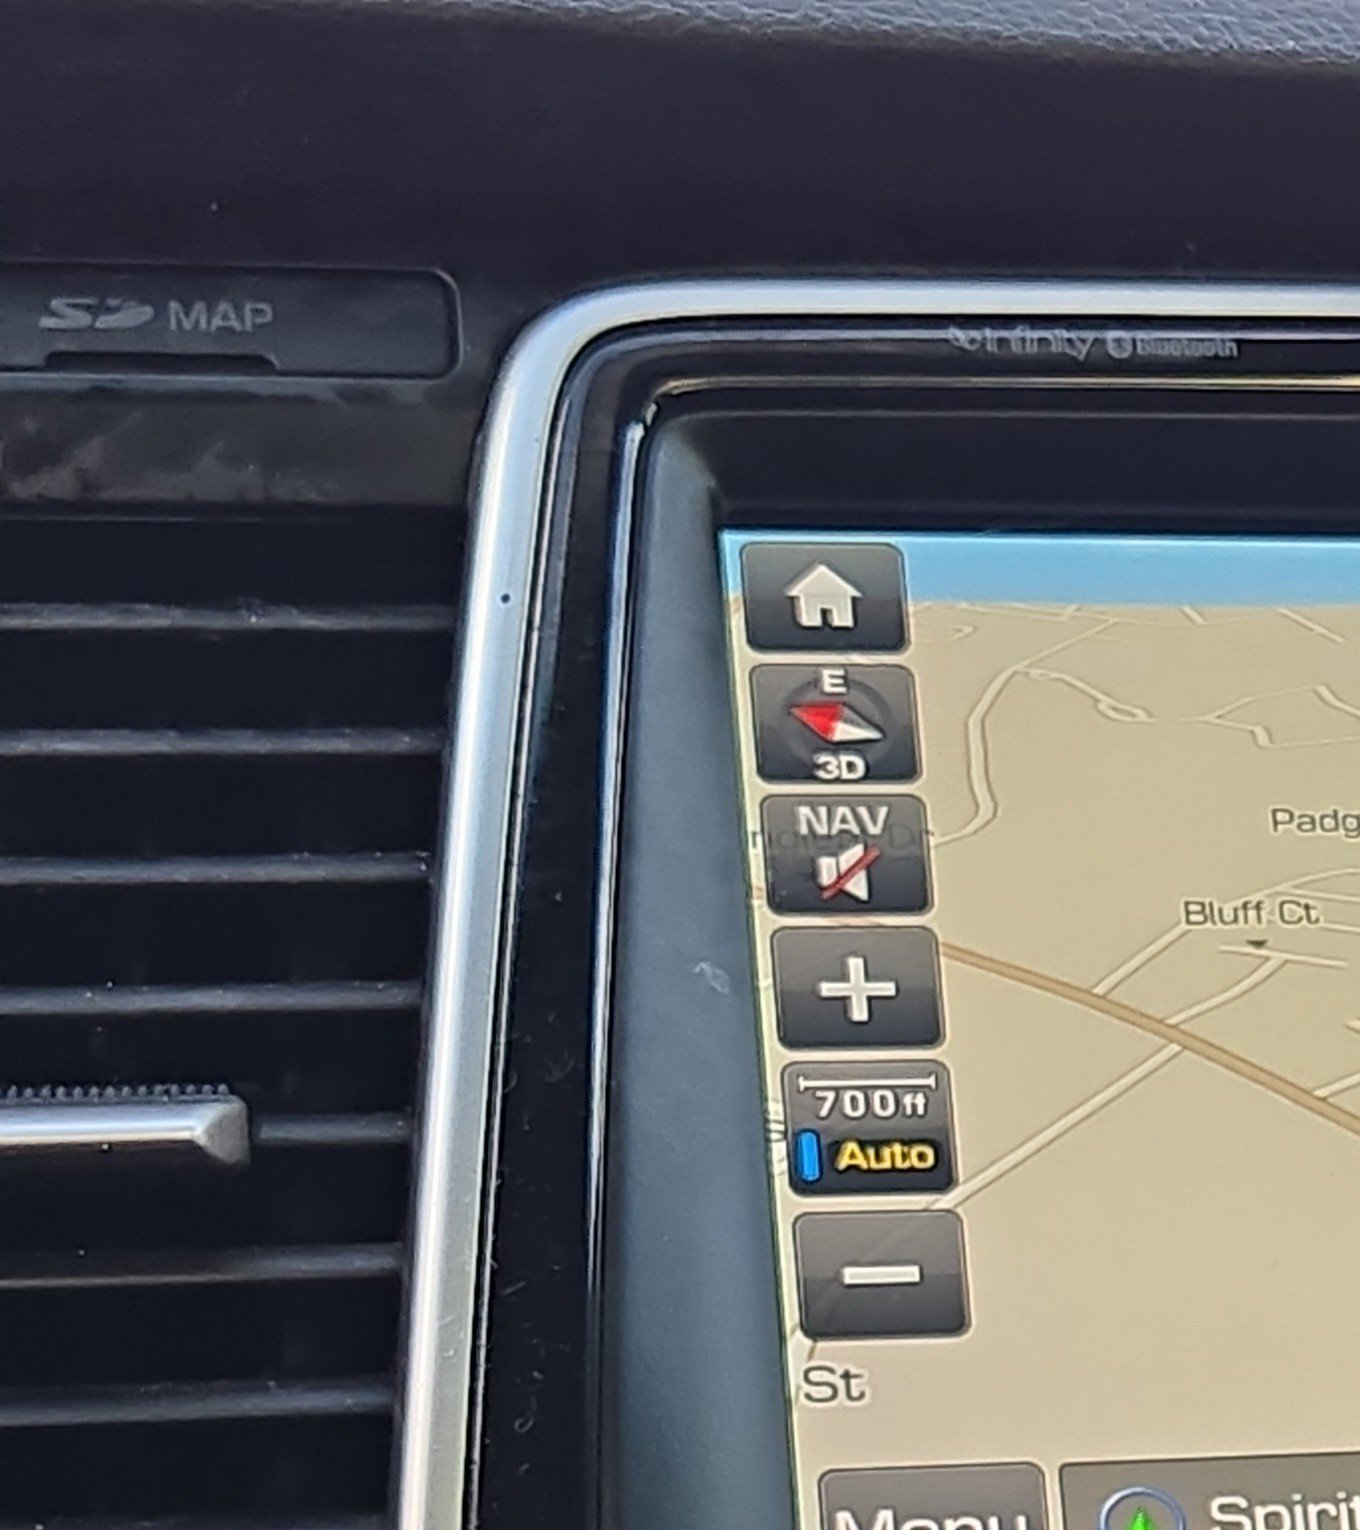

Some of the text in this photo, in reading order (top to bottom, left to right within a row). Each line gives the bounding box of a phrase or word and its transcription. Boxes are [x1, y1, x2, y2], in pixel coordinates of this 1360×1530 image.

[168, 300, 274, 334] MAP
[818, 667, 848, 694] E
[813, 754, 867, 781] 3D
[797, 805, 889, 836] NAV
[1183, 899, 1320, 928] Bluff Ct
[837, 1140, 936, 1172] Auto
[803, 1365, 866, 1403] St
